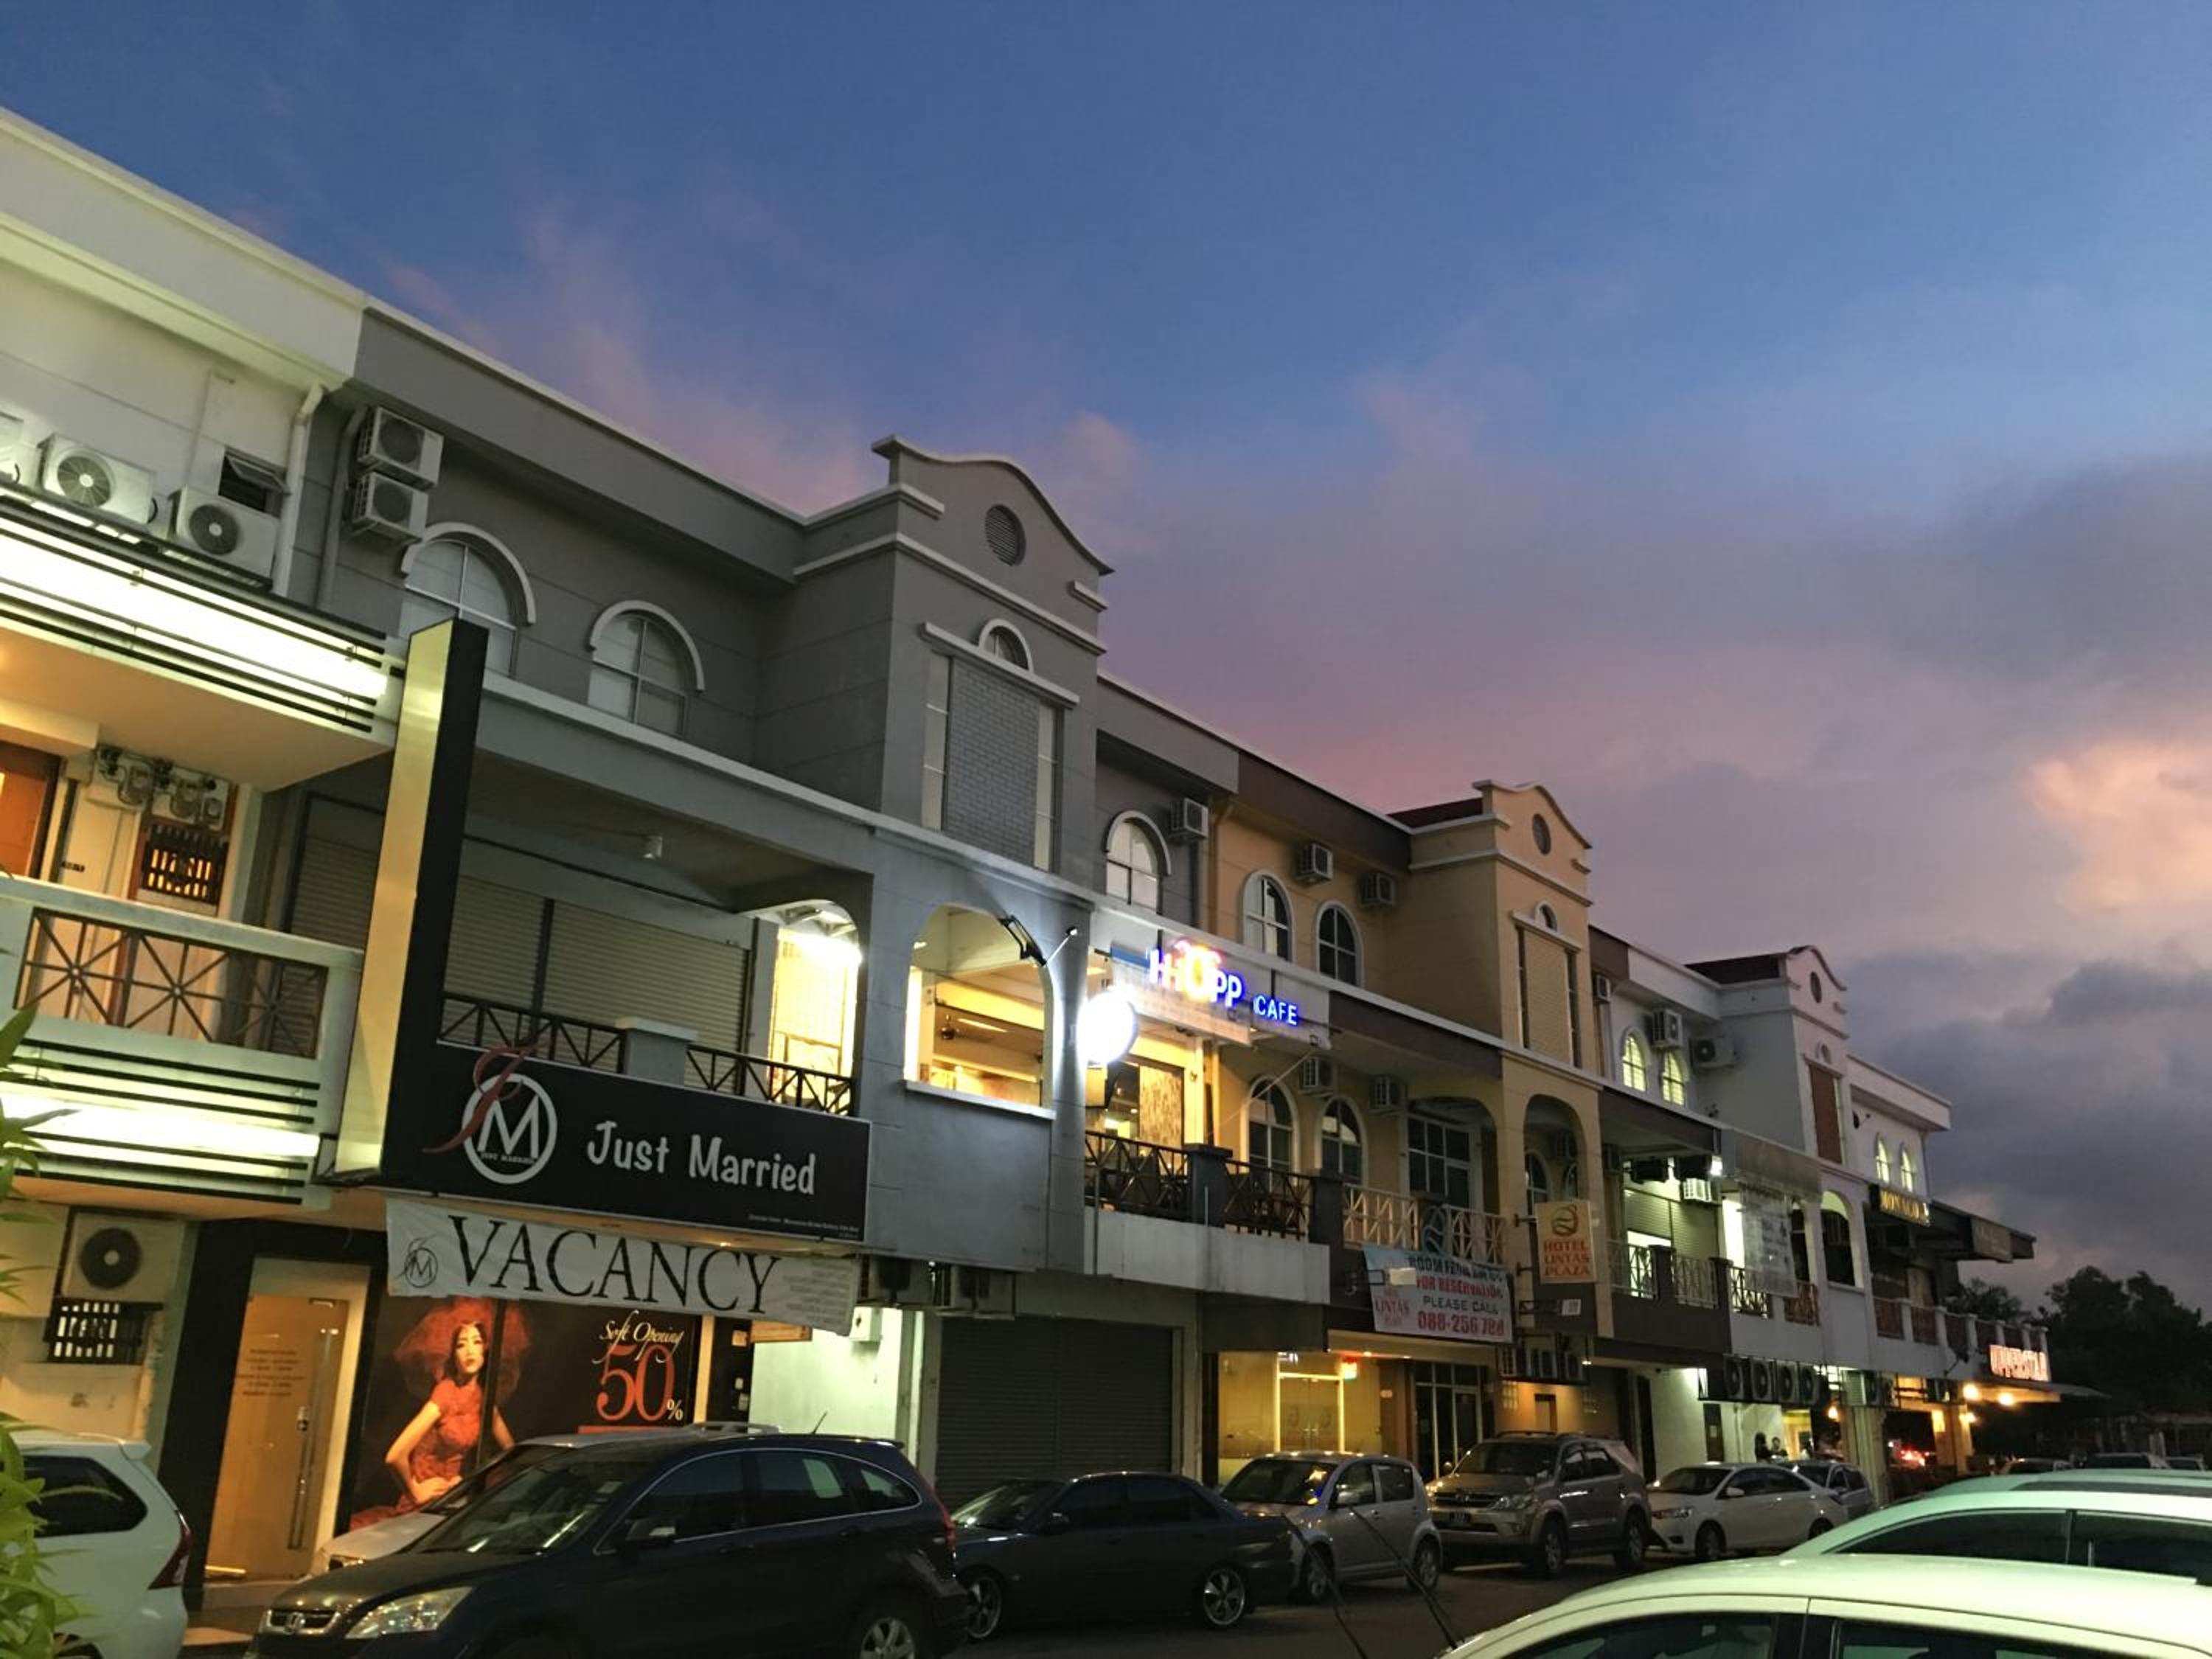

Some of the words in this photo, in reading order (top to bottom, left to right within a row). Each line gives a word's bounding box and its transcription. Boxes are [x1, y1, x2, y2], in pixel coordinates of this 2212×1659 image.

[1253, 995, 1297, 1025] CAFE
[588, 1113, 670, 1173] Just
[688, 1134, 816, 1195] Married
[1543, 1239, 1587, 1252] HOTEL
[448, 1214, 782, 1315] VACANCY
[1545, 1253, 1590, 1265] LINTAS
[1545, 1265, 1590, 1277] PLAZA
[1423, 1295, 1468, 1311] PLEASE
[1472, 1300, 1499, 1315] CALL
[591, 1310, 639, 1364] Soft
[633, 1321, 685, 1363] Opening
